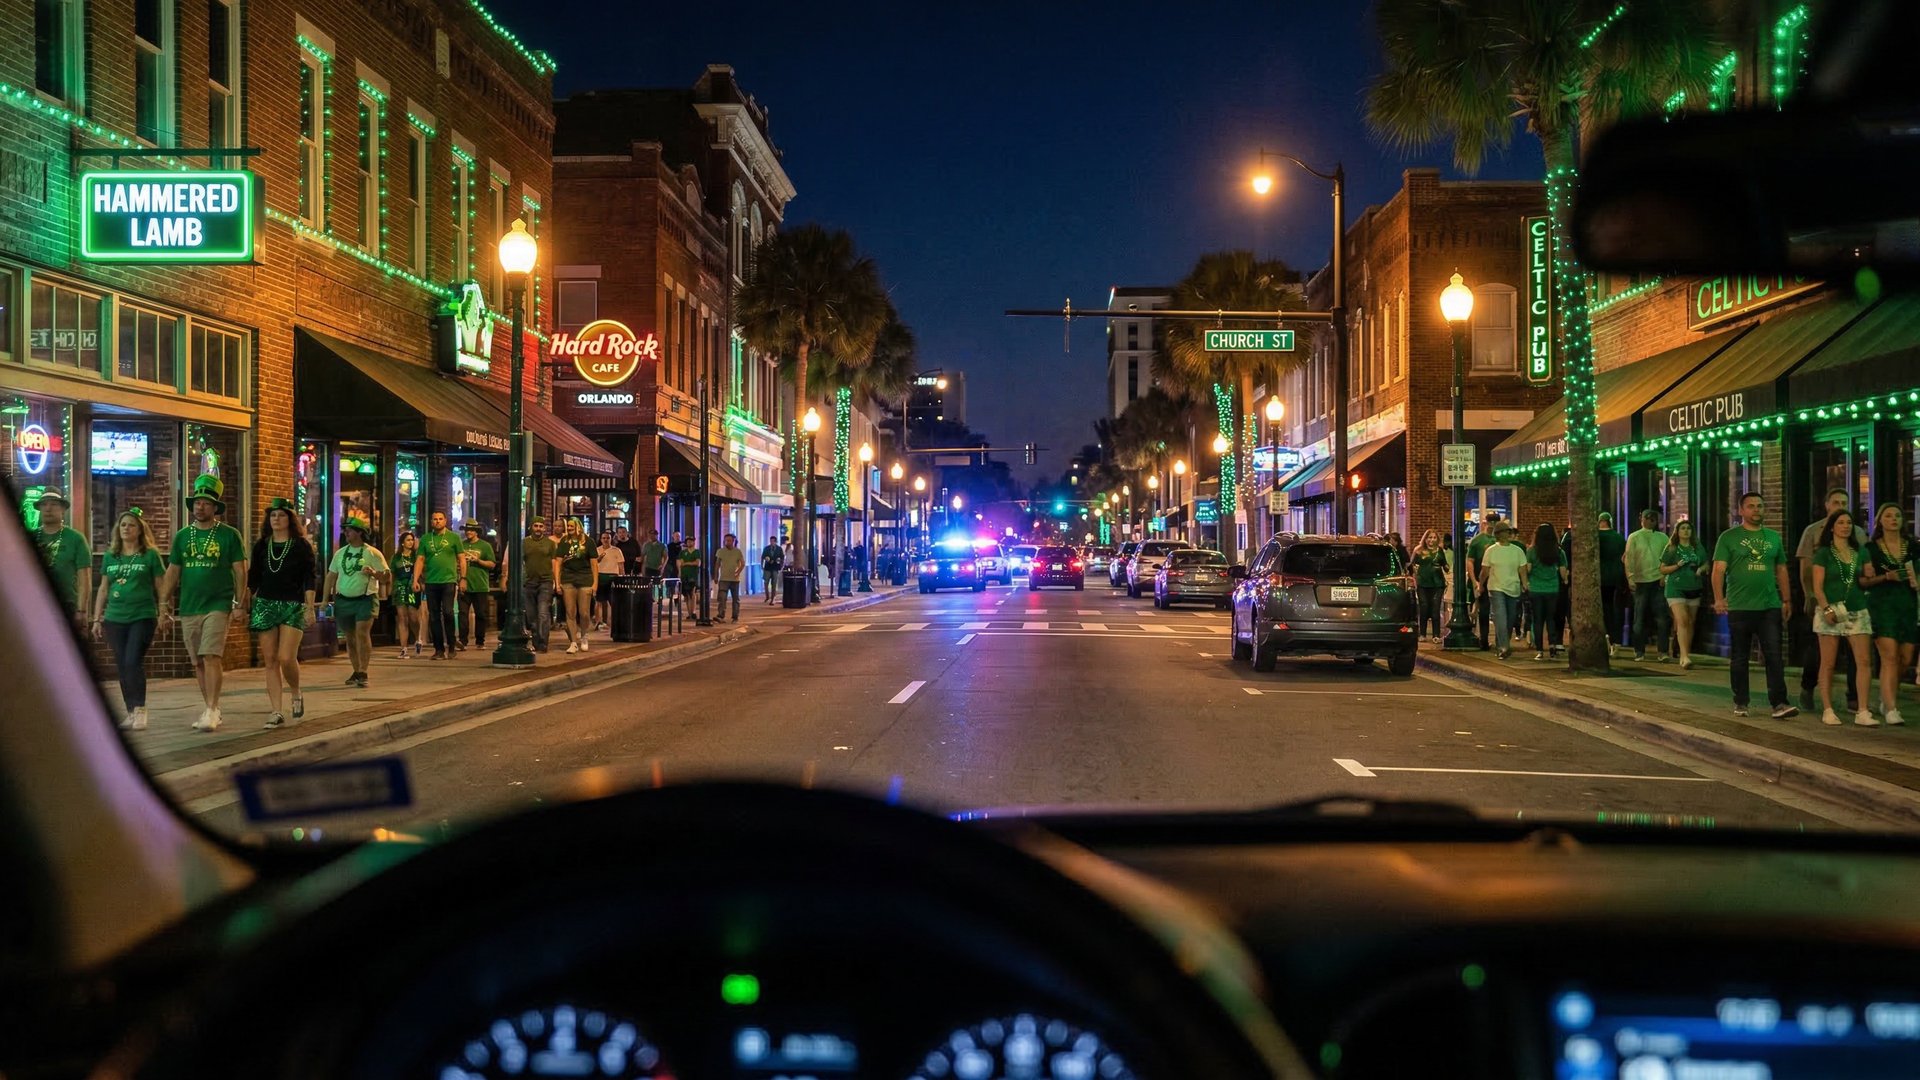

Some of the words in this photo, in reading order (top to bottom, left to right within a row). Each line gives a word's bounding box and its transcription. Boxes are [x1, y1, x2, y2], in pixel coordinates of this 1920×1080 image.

[94, 183, 238, 213] HAMMERED
[130, 217, 203, 246] LAMB
[1531, 221, 1547, 315] CELTIC
[549, 333, 605, 356] Hard
[606, 333, 659, 360] Rock
[1210, 333, 1264, 348] CHURCH
[1272, 333, 1288, 348] ST
[1531, 326, 1547, 373] PUB
[591, 363, 620, 373] CAFE
[577, 393, 634, 404] ORLANDO
[1669, 400, 1713, 432] CELTIC
[1716, 392, 1744, 422] PUB
[20, 430, 50, 450] OPEN
